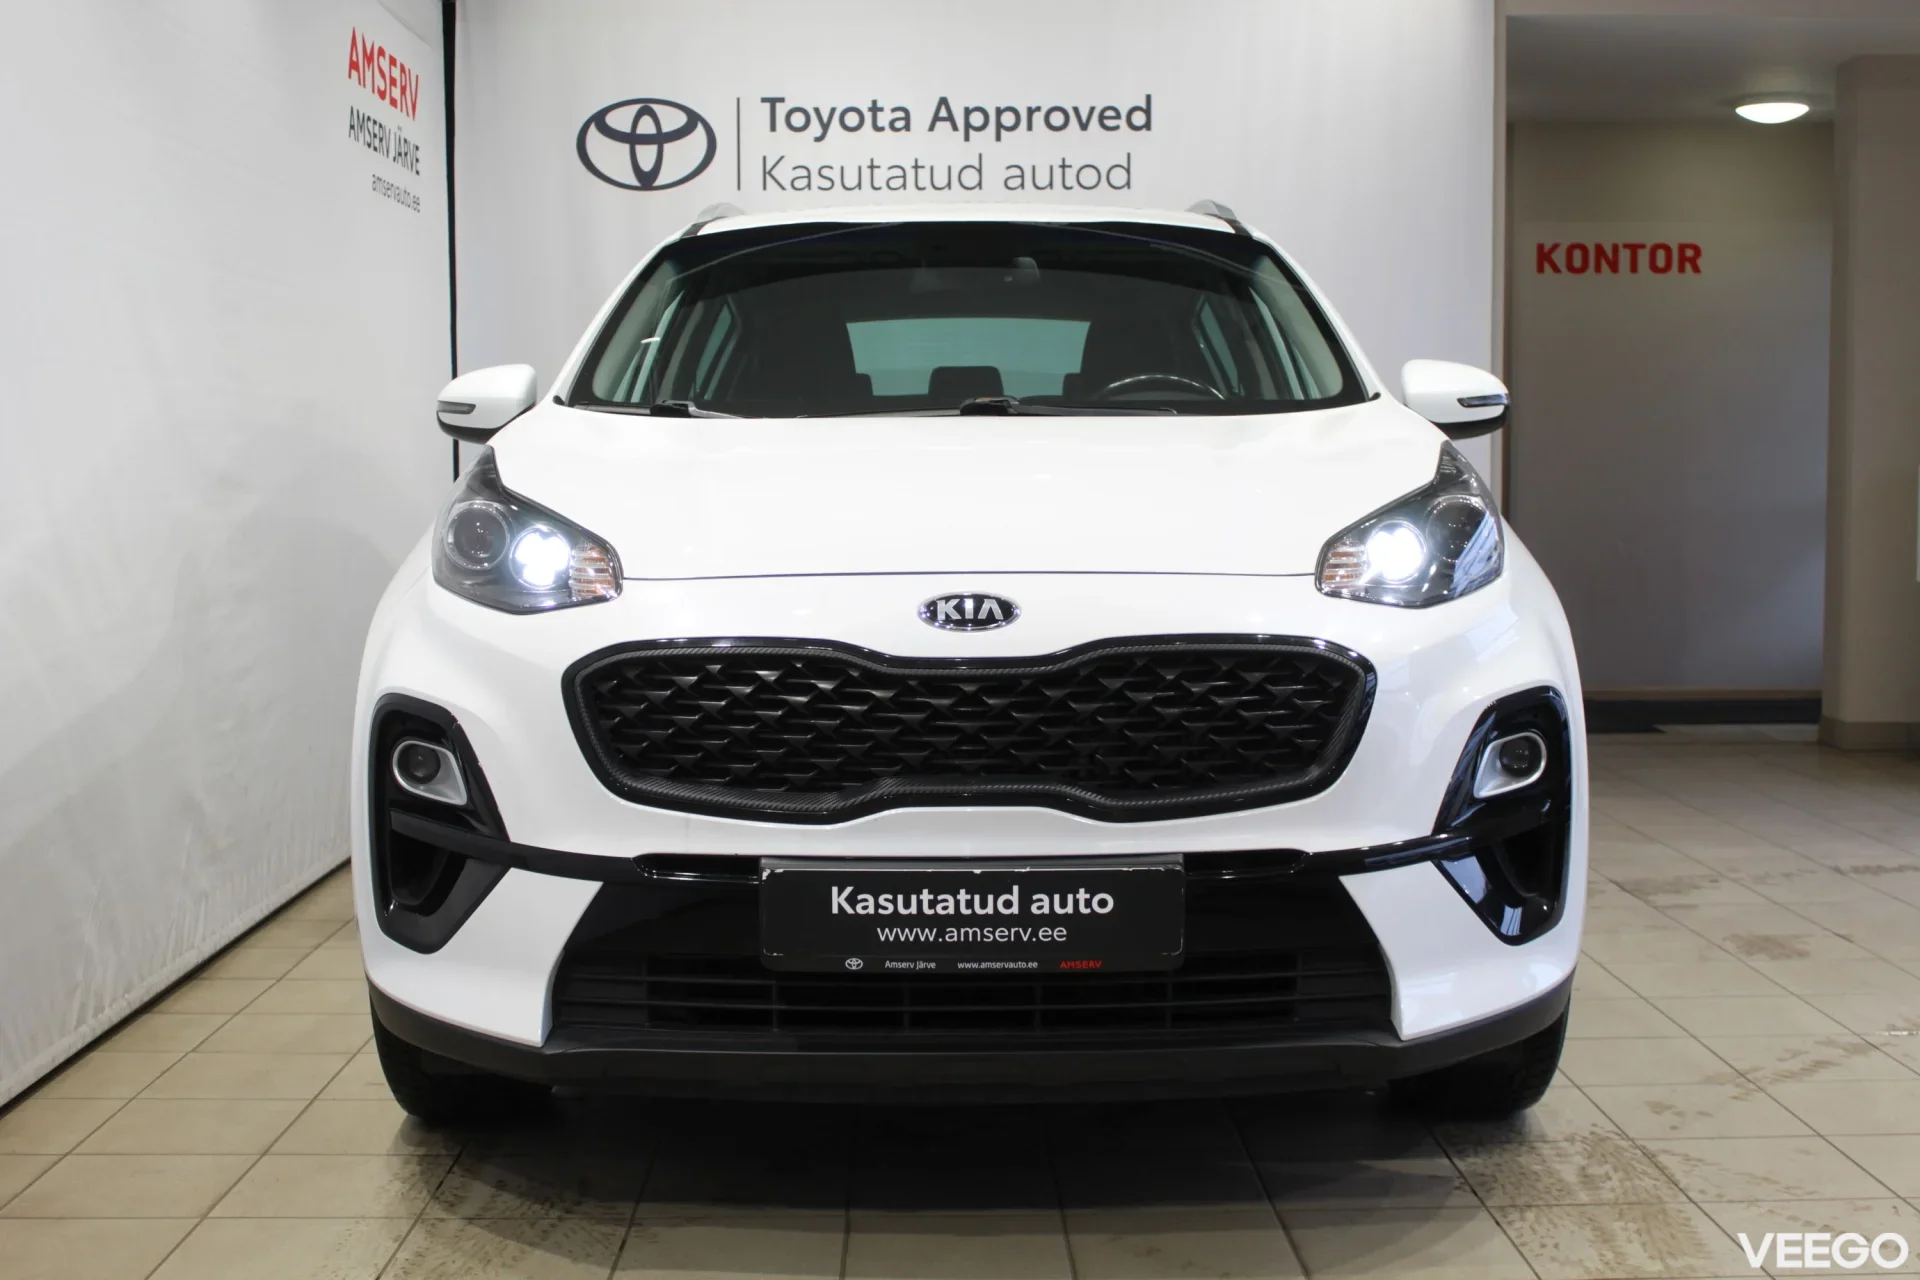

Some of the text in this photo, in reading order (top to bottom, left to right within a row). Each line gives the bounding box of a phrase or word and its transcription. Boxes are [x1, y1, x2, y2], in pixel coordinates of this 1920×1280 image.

[348, 26, 419, 121] AMSERV
[760, 94, 1153, 142] Toyota Approved
[348, 105, 420, 176] AMSERV JÄRVE
[761, 153, 1132, 191] Kasutatud autod
[372, 173, 420, 213] amservauto.ee
[1536, 242, 1703, 275] KONTOR
[936, 598, 1004, 621] KIA
[830, 885, 1115, 916] Kasutatud auto
[876, 925, 1068, 942] www.amserv.ee
[884, 959, 1102, 971] Amserv Järve www.amservauto.ee AMSERV
